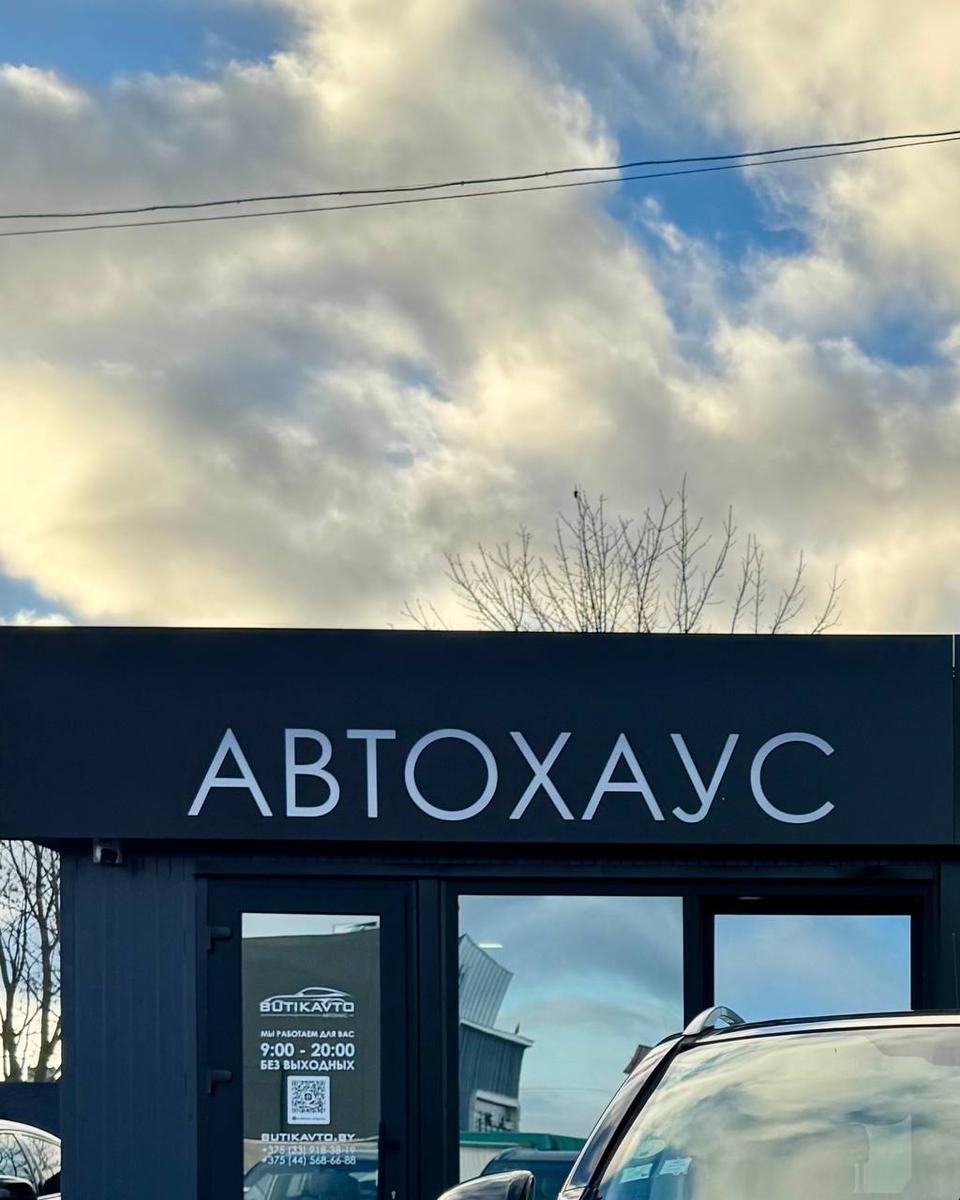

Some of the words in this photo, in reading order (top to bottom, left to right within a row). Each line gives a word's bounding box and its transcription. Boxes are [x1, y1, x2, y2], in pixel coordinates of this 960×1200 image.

[187, 727, 835, 824] АВТОХАУС
[260, 1001, 355, 1013] BUTIKAVTO
[261, 1030, 275, 1038] МЫ
[277, 1030, 318, 1038] РАБОТАЕМ
[320, 1030, 336, 1039] ДЛЯ
[338, 1030, 355, 1038] ВАС
[260, 1043, 294, 1057] 9:00
[311, 1043, 355, 1057] 20:00
[260, 1060, 280, 1070] БЕЗ
[284, 1060, 355, 1071] ВЫХОДНЫХ
[261, 1133, 356, 1142] BUTIKAVTO.BY
[288, 1155, 306, 1167] (44)
[309, 1155, 356, 1165] 568-66-88
